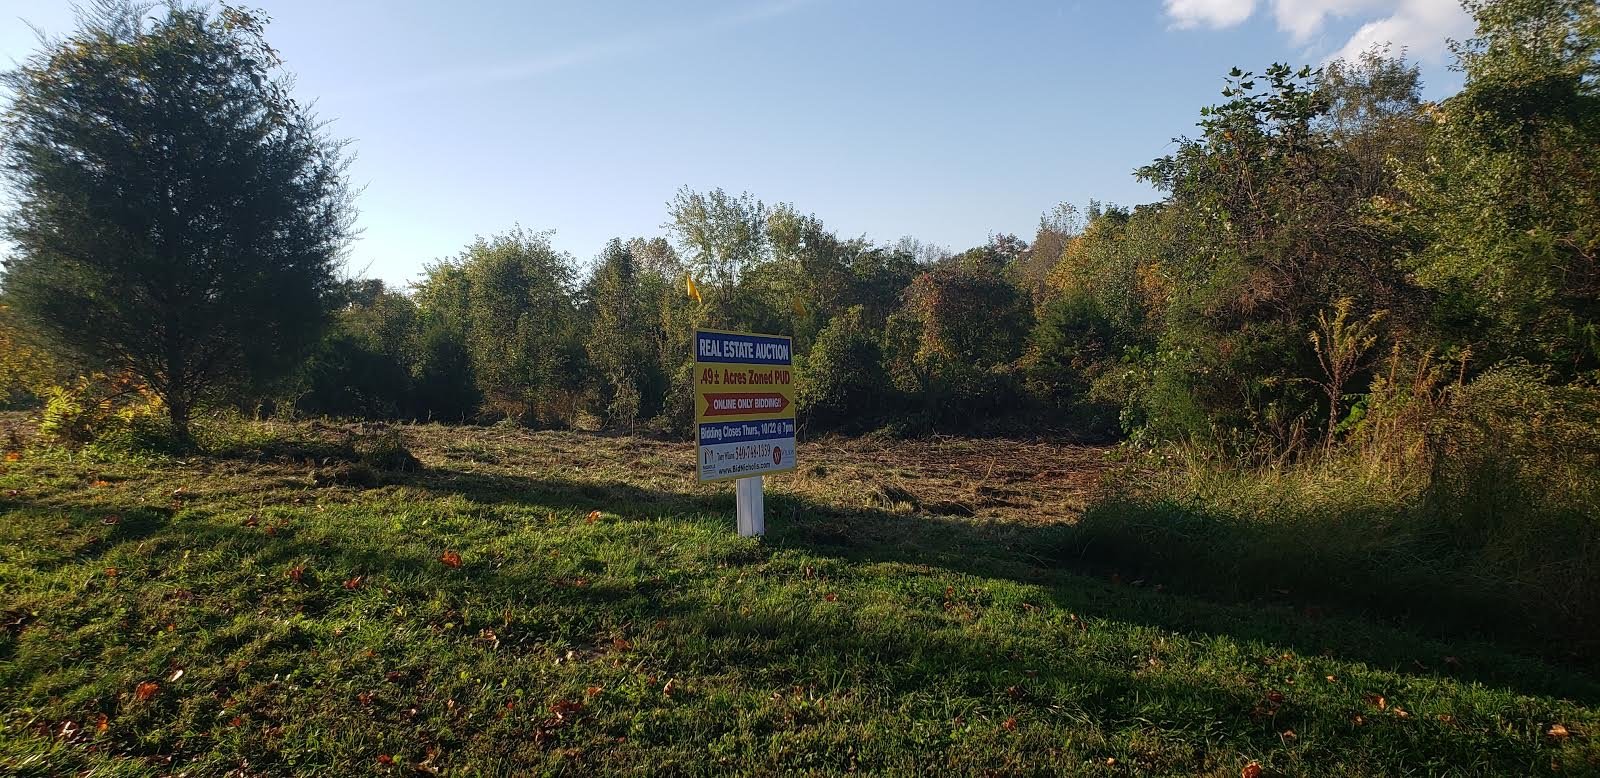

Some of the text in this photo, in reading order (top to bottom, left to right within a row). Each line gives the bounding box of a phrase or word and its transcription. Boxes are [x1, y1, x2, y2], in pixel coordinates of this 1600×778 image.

[700, 339, 789, 361] REAL ESTATE AUCTION
[723, 369, 747, 385] Acres
[748, 370, 773, 385] Zoned
[774, 371, 791, 385] PUD
[713, 399, 737, 410] ONLINE
[738, 399, 753, 409] ONLY
[701, 427, 722, 441] Bidding
[722, 425, 742, 438] Closes
[761, 422, 777, 435] 10/22
[777, 423, 782, 434] @
[783, 422, 793, 434] 7pm
